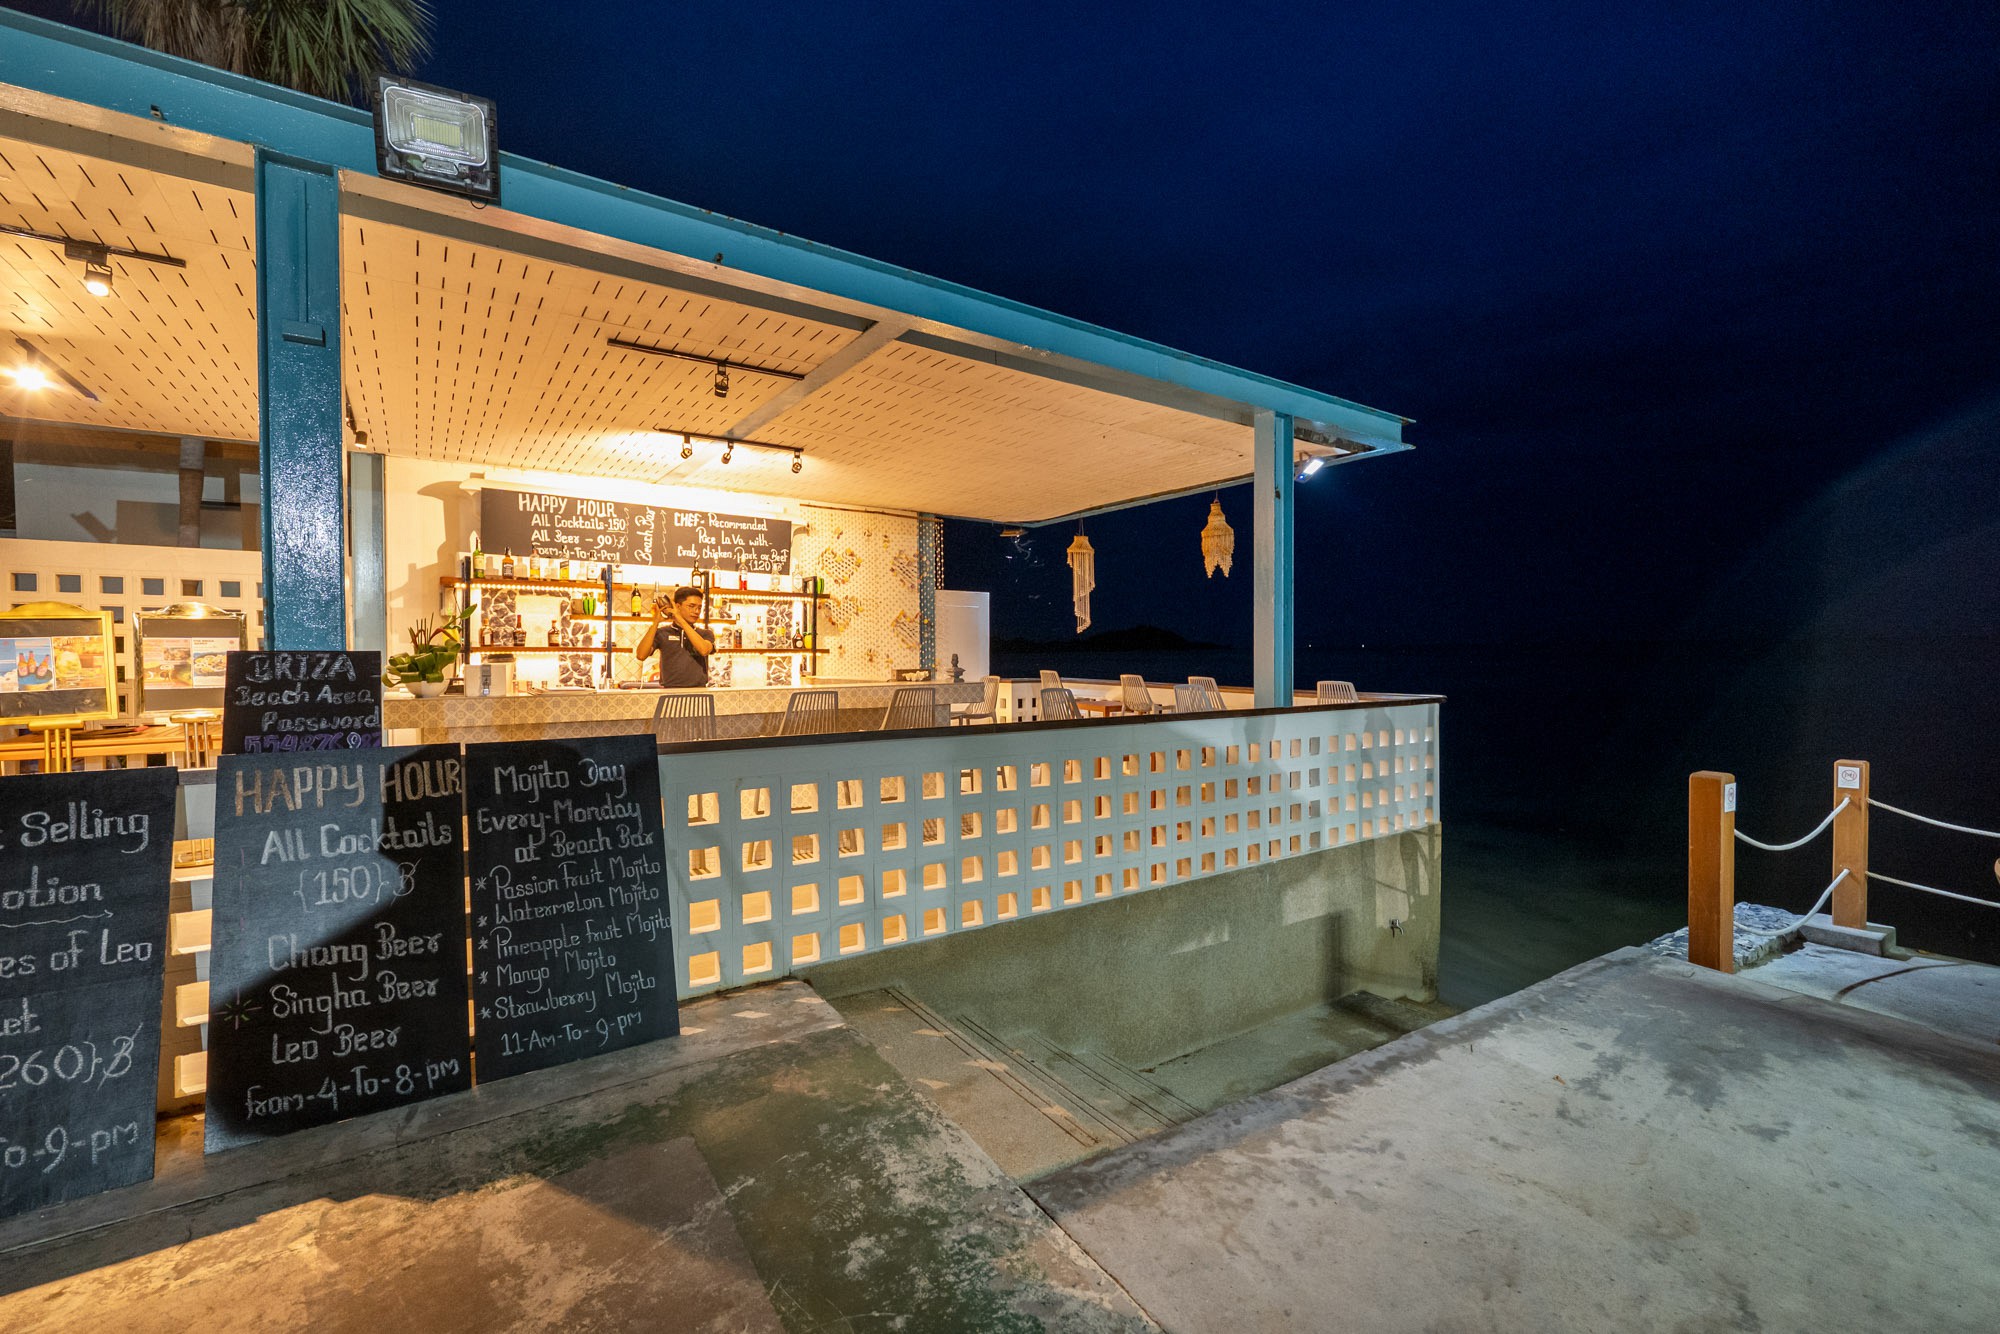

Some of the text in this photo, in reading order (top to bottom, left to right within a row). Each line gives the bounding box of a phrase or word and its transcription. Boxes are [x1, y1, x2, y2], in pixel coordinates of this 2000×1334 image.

[518, 493, 617, 518] HAPPY HOUR
[708, 512, 768, 531] Recommended
[554, 530, 580, 544] Beer
[696, 527, 716, 544] Rice
[245, 652, 357, 683] BRIZA
[233, 682, 310, 706] Beach
[261, 705, 381, 732] Password
[235, 758, 463, 816] HAPPY HOUR
[494, 758, 628, 803] Mojito Day
[20, 800, 149, 854] Selling
[320, 811, 452, 858] Cocktails
[514, 824, 653, 863] at Beach Bar
[489, 865, 559, 900] Passion
[609, 853, 661, 886] Mojito
[496, 882, 659, 924] Watermelon Mojito
[50, 929, 89, 971] of
[100, 928, 153, 965] Leo
[268, 922, 443, 981] Chang Beer
[489, 923, 580, 960] Pineapple
[626, 908, 672, 942] Mojito
[496, 947, 616, 995] Mango Mojito
[270, 970, 440, 1034] Singha Beer
[495, 970, 656, 1020] Strawberry Mojito
[0, 997, 41, 1036] et
[271, 1023, 401, 1064] Leo Beer
